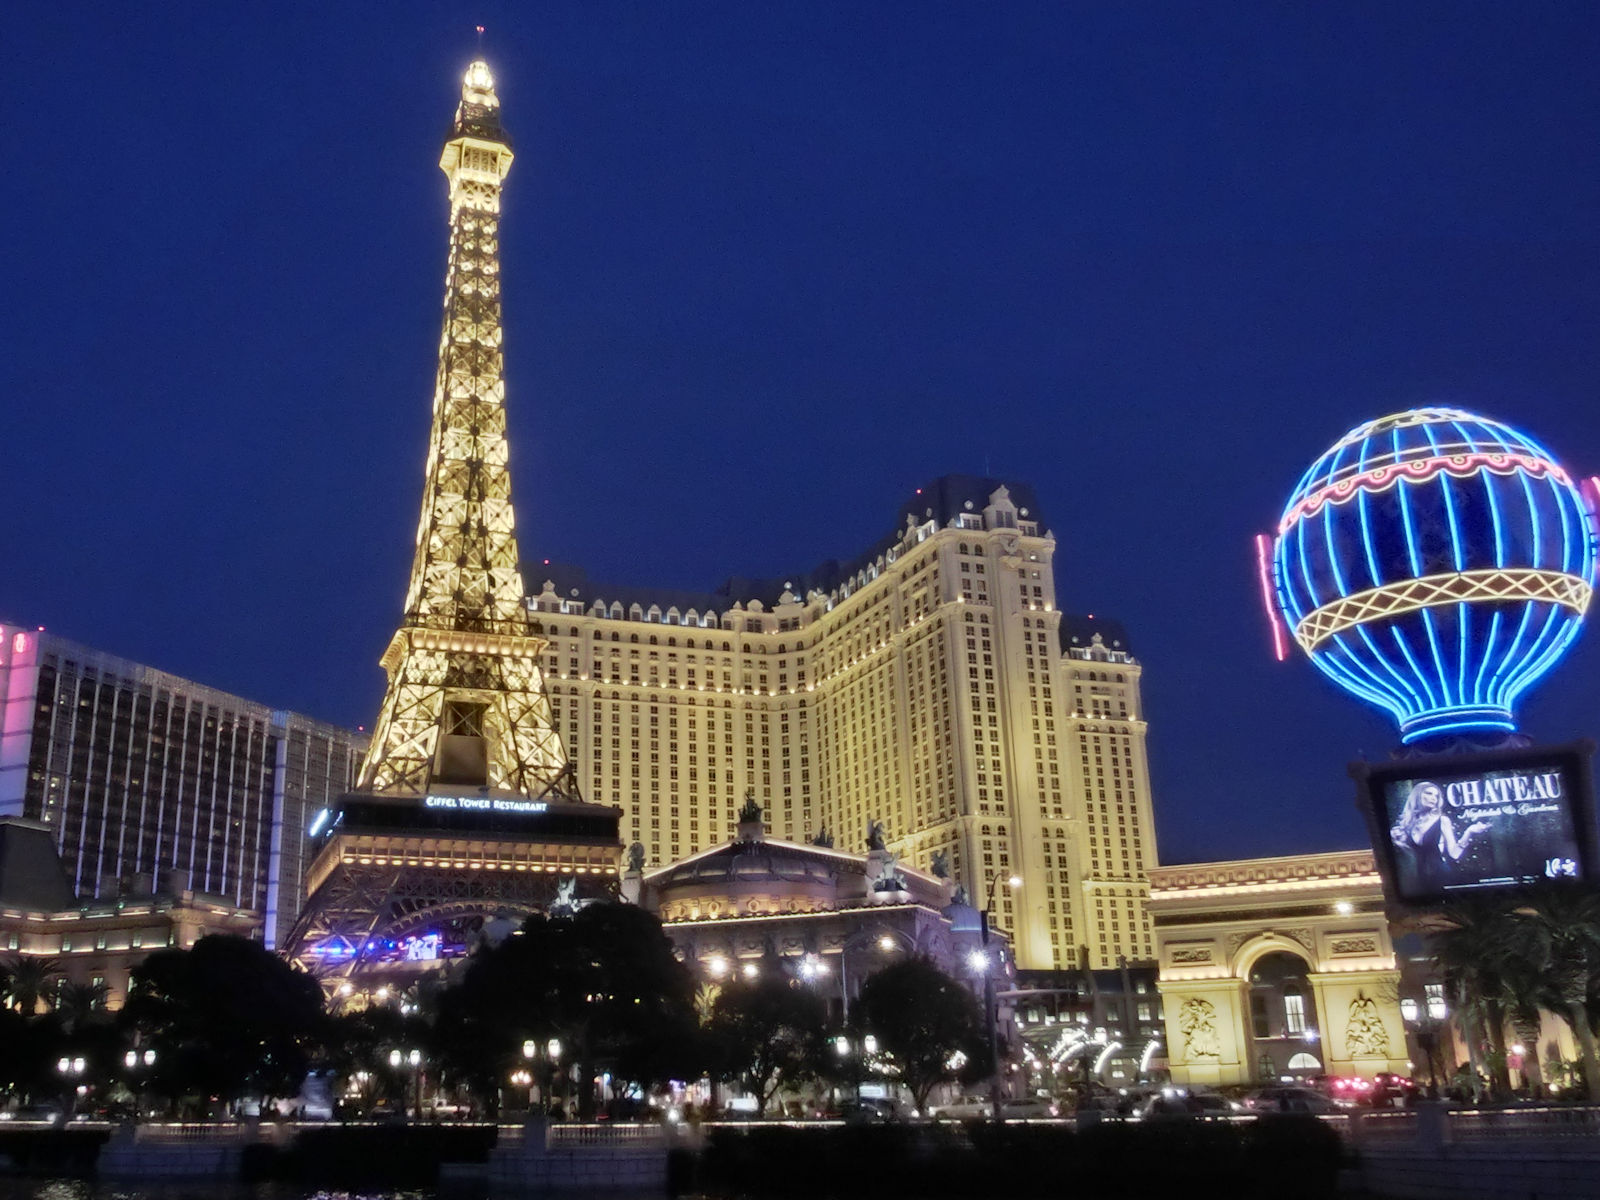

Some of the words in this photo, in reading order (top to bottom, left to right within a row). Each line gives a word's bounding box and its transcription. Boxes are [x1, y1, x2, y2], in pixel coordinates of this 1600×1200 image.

[1446, 773, 1561, 808] CHATEAU
[425, 796, 457, 808] EIFFEL
[458, 797, 491, 809] TOWER
[493, 800, 547, 811] RESTAURANT
